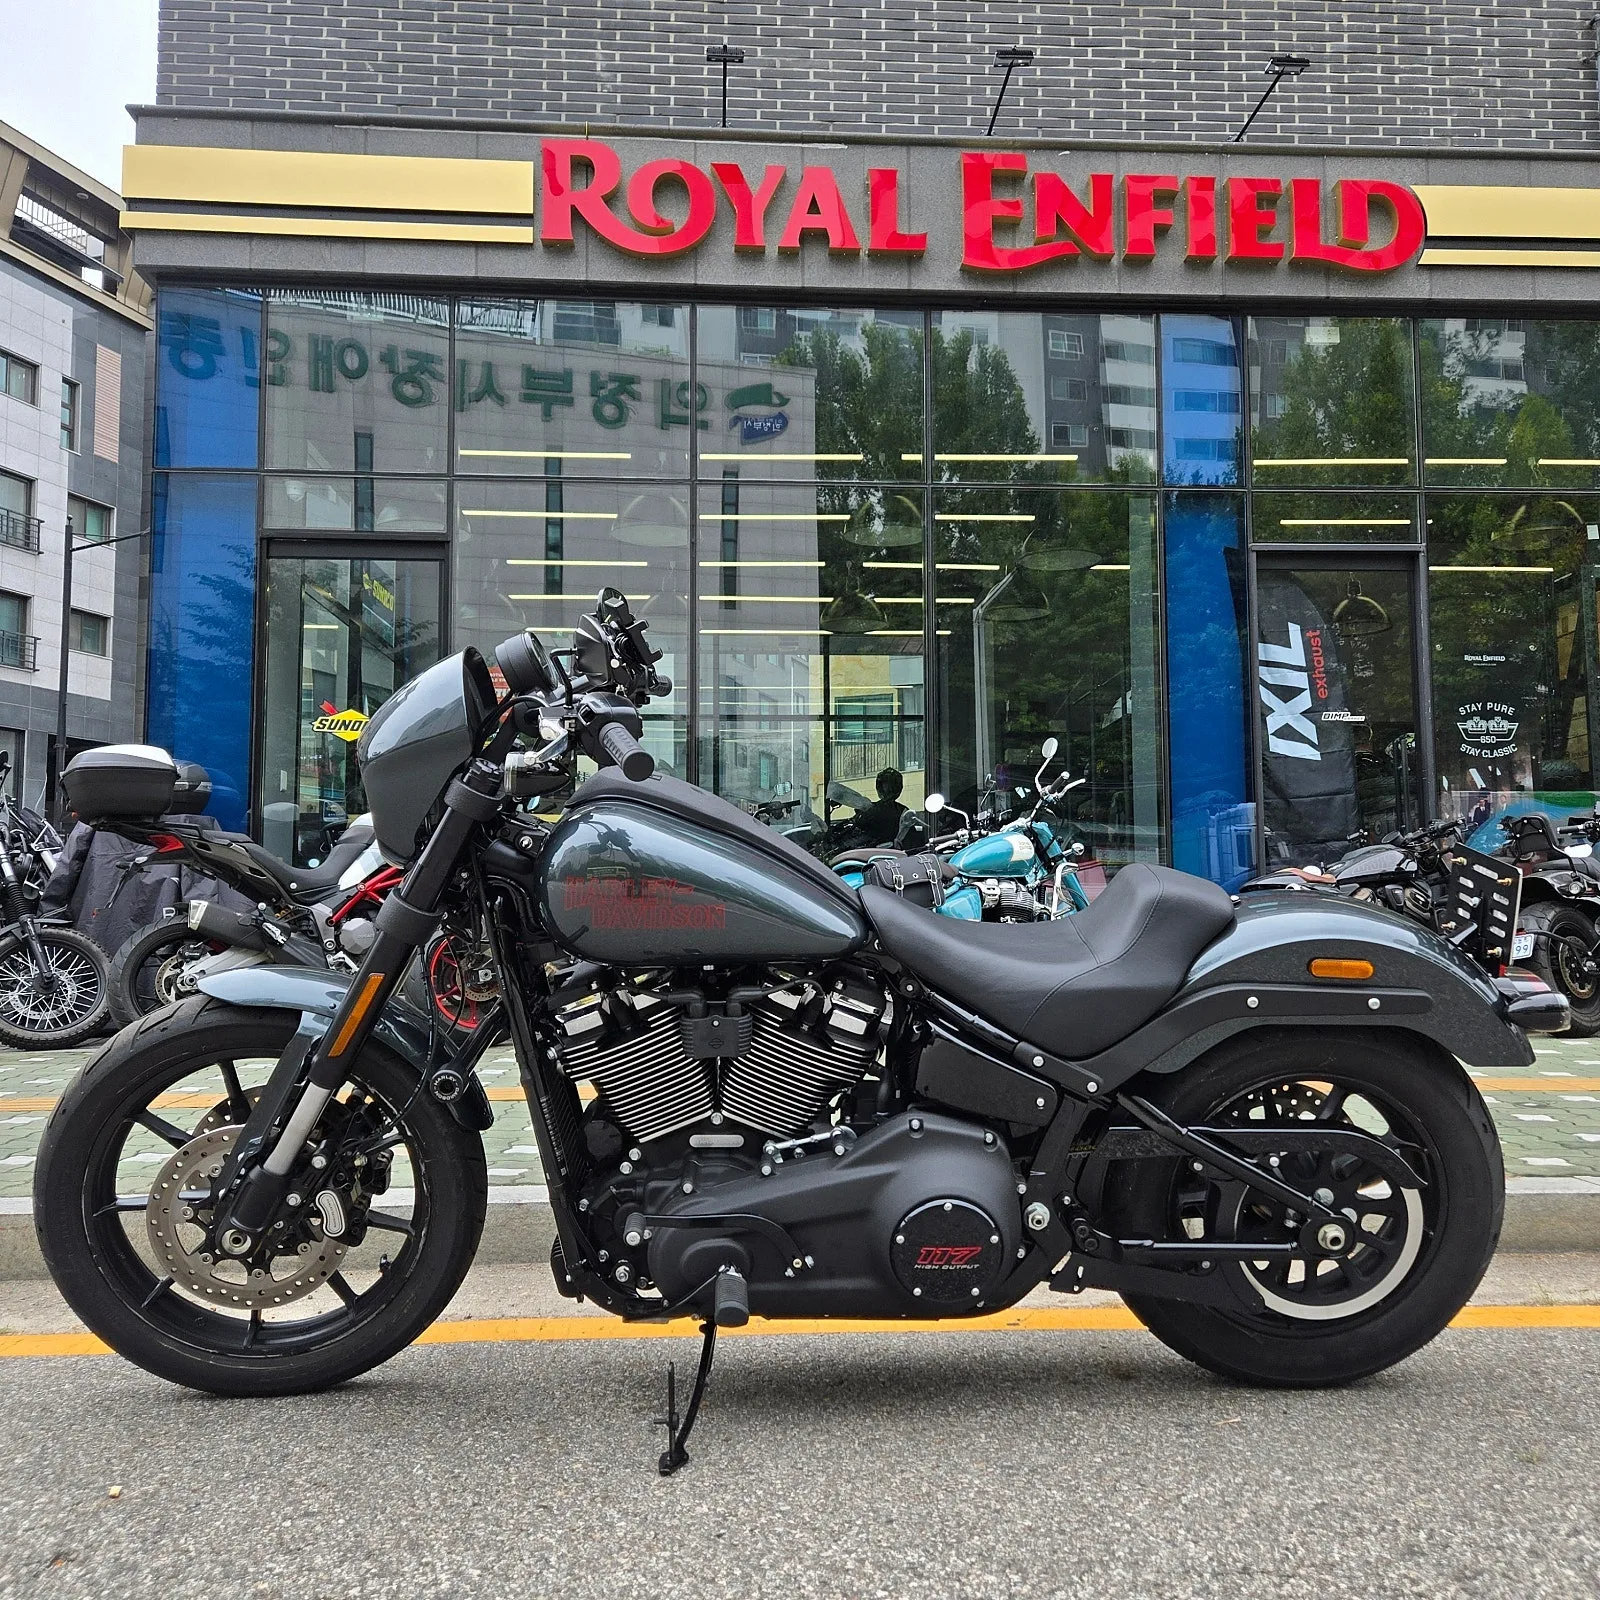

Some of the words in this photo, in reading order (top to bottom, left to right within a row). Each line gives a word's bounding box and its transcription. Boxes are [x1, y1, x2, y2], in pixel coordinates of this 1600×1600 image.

[540, 138, 927, 258] ROYAL
[961, 150, 1427, 272] ENFIELD
[1305, 629, 1328, 699] exhaust
[1459, 702, 1483, 716] STAY
[1487, 702, 1516, 716] PURE
[1480, 735, 1497, 744] 650
[1460, 743, 1481, 757] STAY
[1481, 743, 1518, 758] CLASSIC
[592, 904, 726, 928] DAVIDSON
